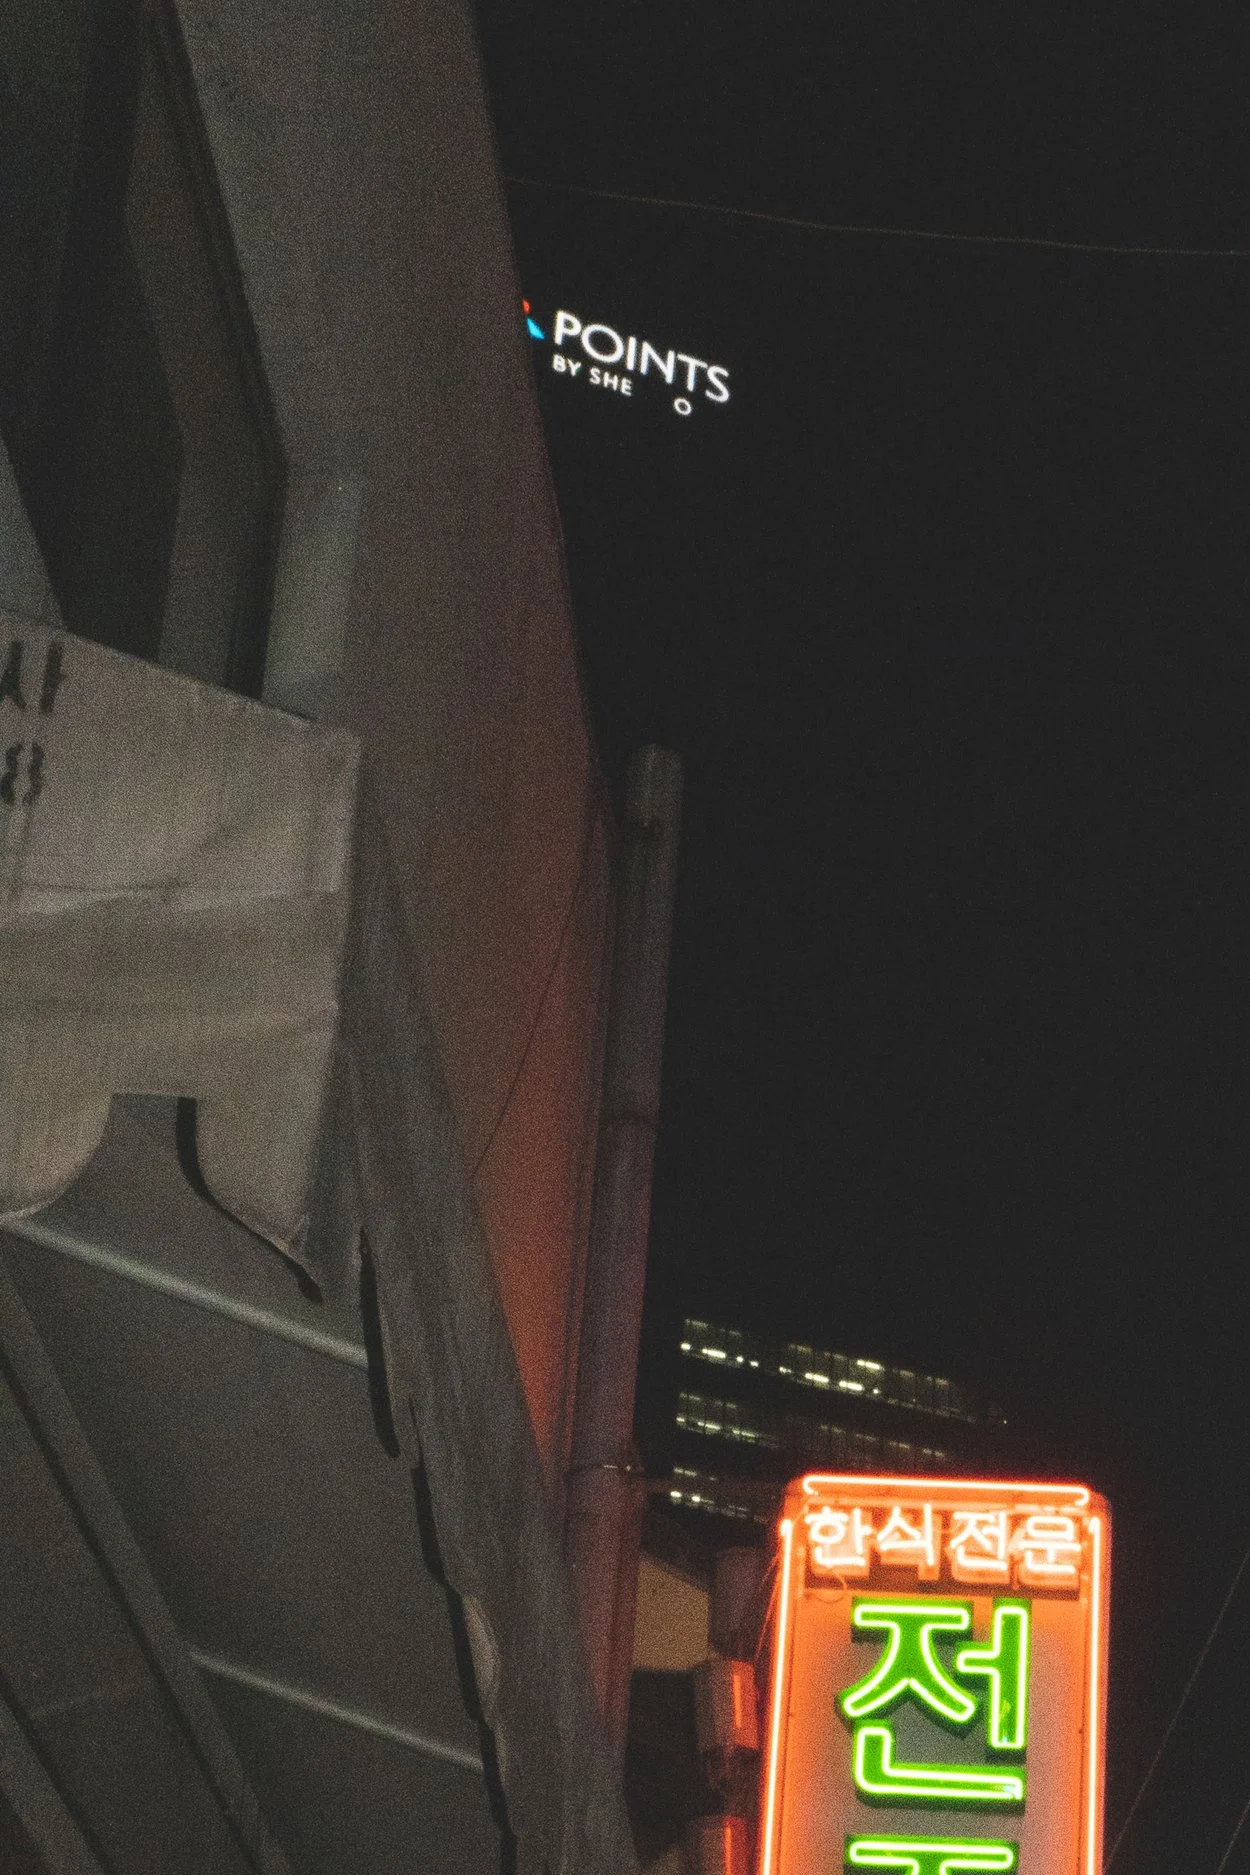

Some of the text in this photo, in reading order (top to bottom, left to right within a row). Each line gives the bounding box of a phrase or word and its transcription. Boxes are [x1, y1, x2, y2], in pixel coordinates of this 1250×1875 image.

[551, 353, 582, 377] BY
[553, 309, 731, 404] POINTS
[804, 1503, 1082, 1574] 한식전문
